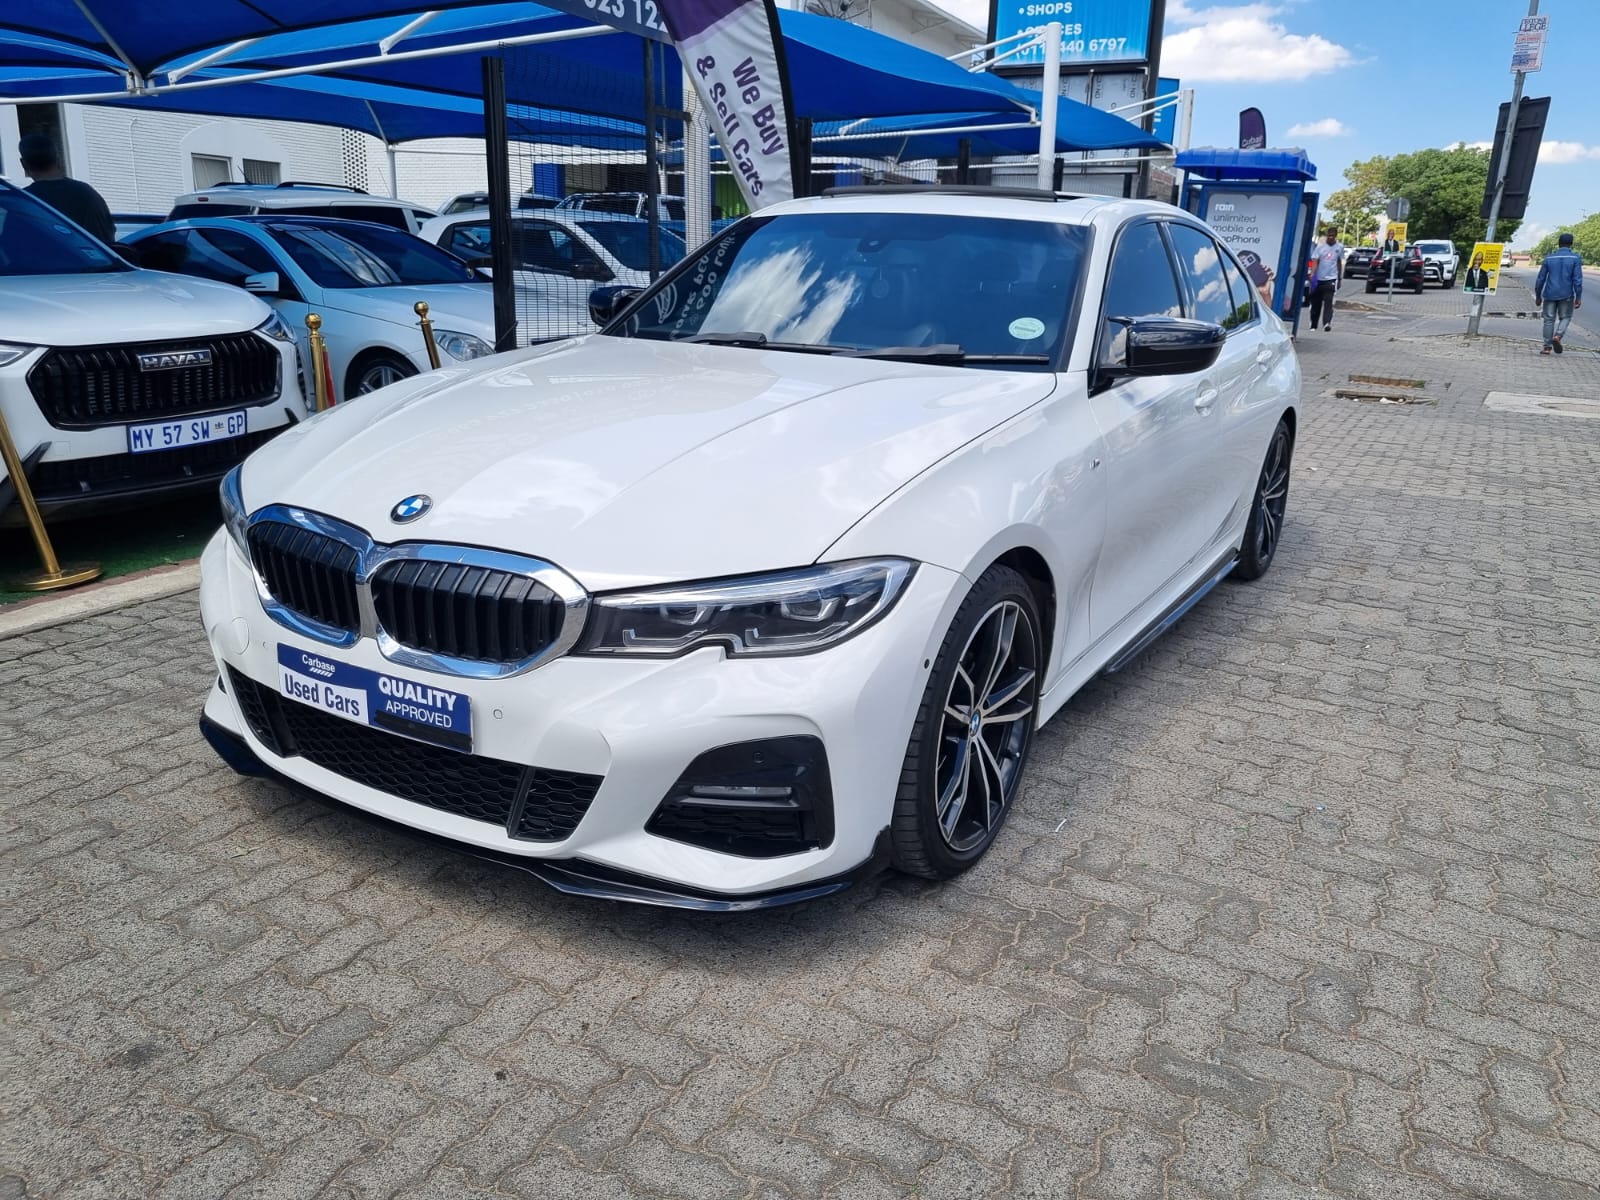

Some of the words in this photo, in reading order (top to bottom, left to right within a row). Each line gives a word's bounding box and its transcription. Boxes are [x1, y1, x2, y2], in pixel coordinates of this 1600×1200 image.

[1027, 2, 1073, 16] SHOPS
[1089, 37, 1127, 52] 6797
[732, 55, 761, 105] We
[752, 103, 785, 156] Buy
[696, 54, 717, 80] &
[708, 82, 740, 137] Sell
[732, 137, 764, 197] Cars
[1215, 203, 1235, 211] rain
[1212, 224, 1244, 233] mobile
[1213, 214, 1257, 223] unlimited
[143, 353, 209, 368] HAVAL
[132, 428, 154, 450] MY
[163, 424, 182, 445] 57
[191, 420, 210, 441] SW
[227, 414, 244, 435] GP
[302, 653, 336, 673] Carbase
[284, 673, 320, 705] Used
[324, 686, 360, 716] Cars
[378, 676, 457, 712] QUALITY
[384, 699, 453, 729] APPROVED
